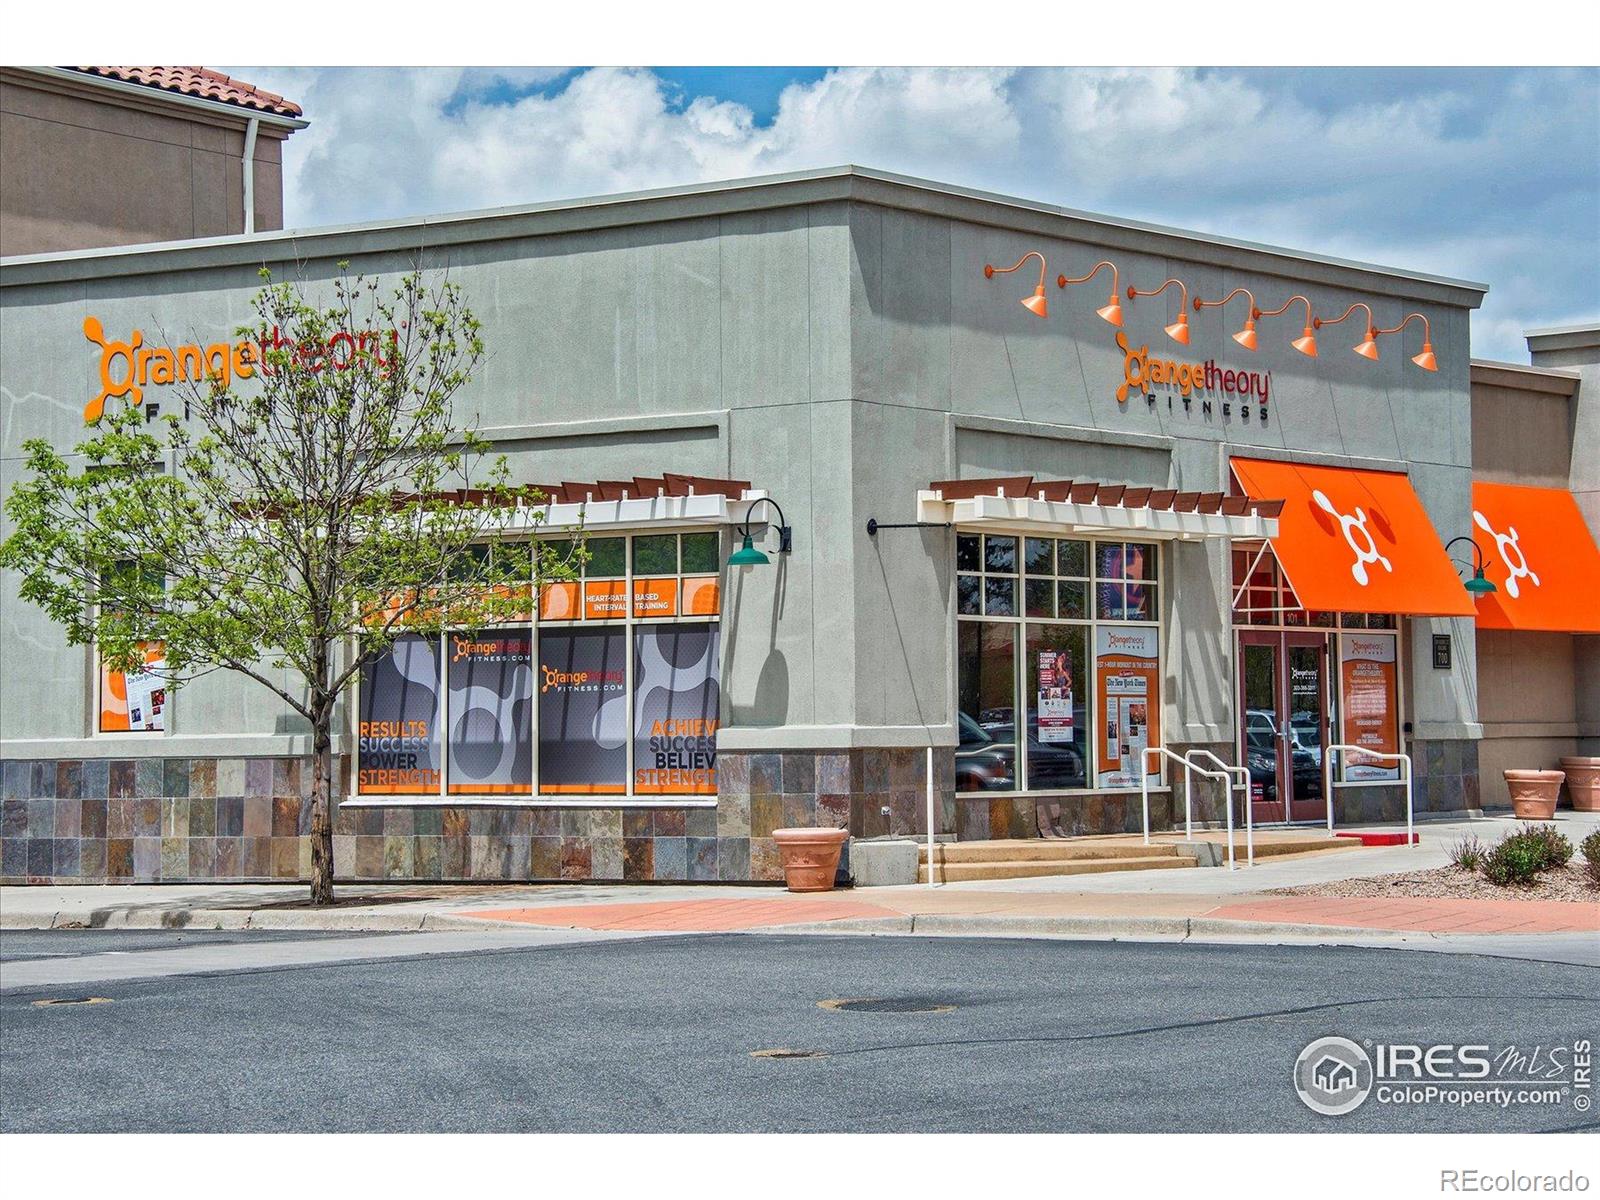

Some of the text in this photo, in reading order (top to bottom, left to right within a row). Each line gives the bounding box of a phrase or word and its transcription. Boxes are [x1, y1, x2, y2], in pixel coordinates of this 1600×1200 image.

[1116, 331, 1269, 404] Orangetheory
[1148, 394, 1268, 420] FITNESS
[634, 593, 659, 601] BASED
[593, 602, 669, 611] INTERVAL TRAINING
[1287, 612, 1298, 624] 101
[360, 720, 427, 737] RESULTS
[651, 719, 718, 736] ACHIEV
[360, 736, 430, 752] SUCCESS
[649, 735, 717, 753] SUCCES
[656, 752, 717, 769] BELIEV
[360, 768, 442, 785] STRENGTH
[635, 768, 716, 785] STRENGT
